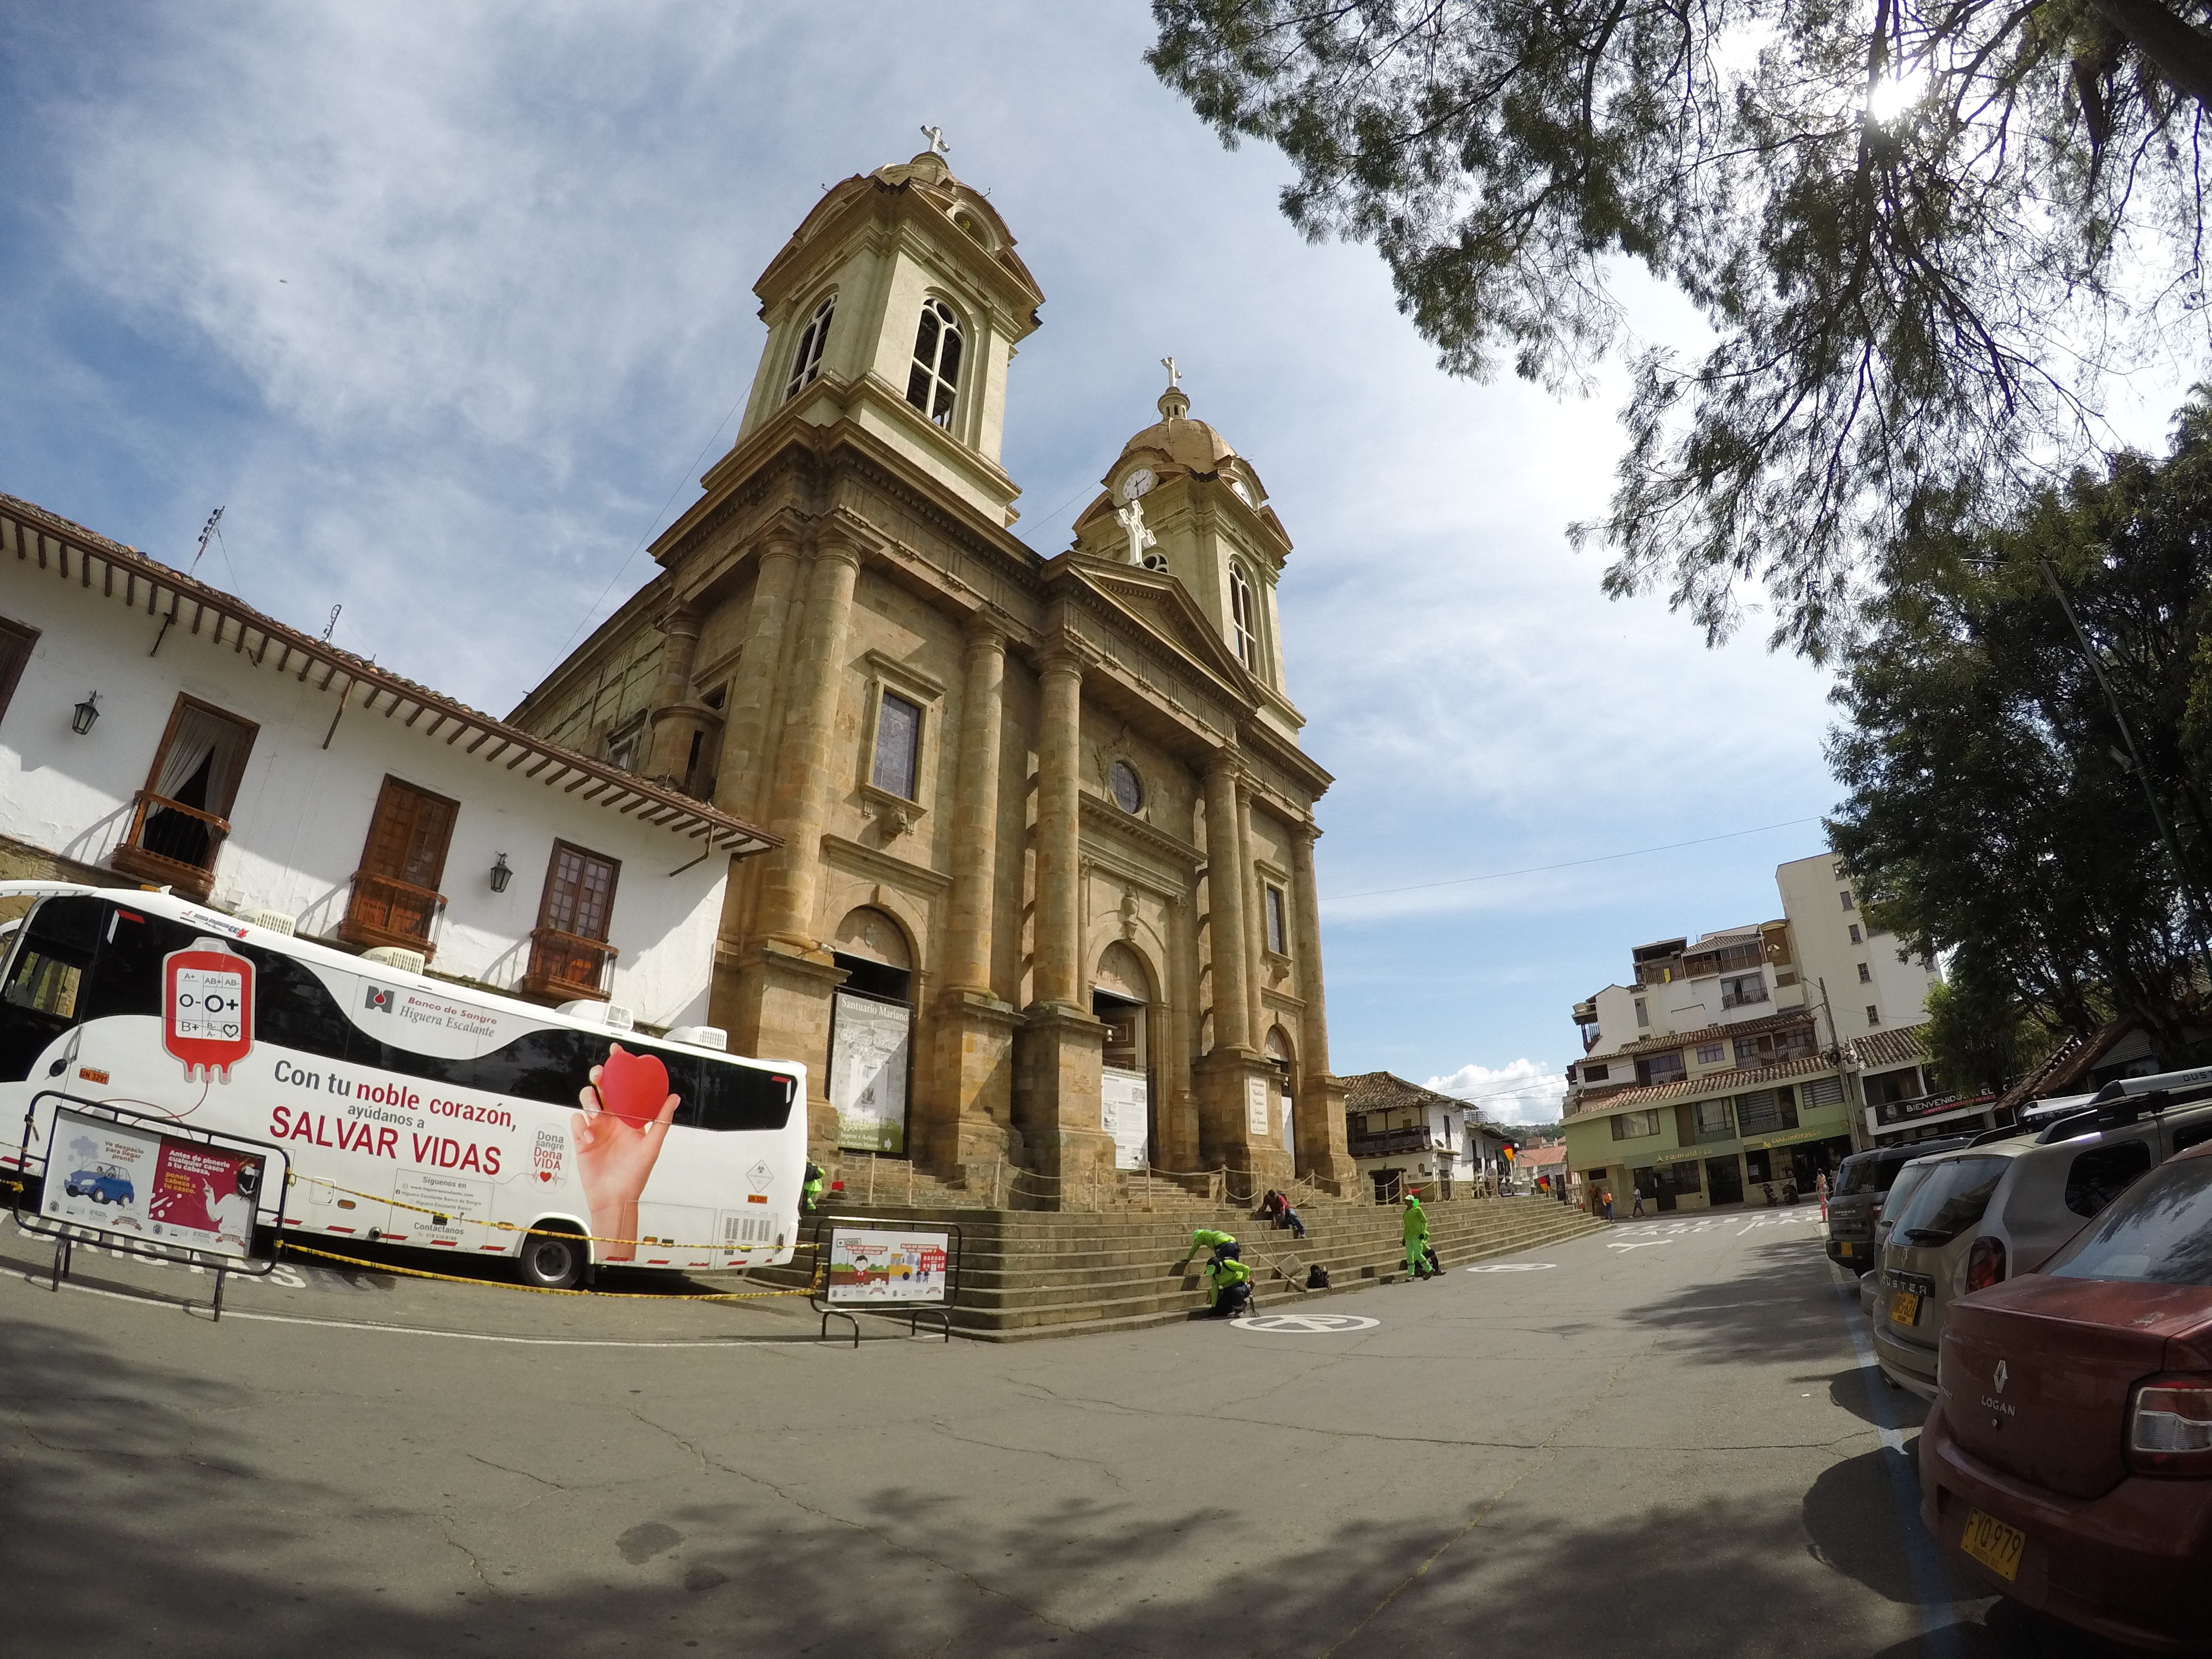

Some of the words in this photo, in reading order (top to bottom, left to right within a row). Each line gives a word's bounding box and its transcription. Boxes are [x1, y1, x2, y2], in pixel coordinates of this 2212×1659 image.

[179, 994, 201, 1008] O-
[205, 995, 238, 1013] O+
[408, 997, 441, 1011] Banco
[444, 1006, 457, 1015] de
[460, 1010, 497, 1024] Sangre
[842, 997, 877, 1015] Santuario
[879, 1006, 908, 1022] Mariano
[181, 1021, 199, 1031] B+
[399, 1005, 442, 1026] Higuera
[446, 1017, 494, 1037] Escalante
[274, 1060, 320, 1090] Con
[328, 1073, 351, 1097] tu
[356, 1083, 420, 1110] noble
[429, 1103, 517, 1131] corazón,
[1981, 1087, 1994, 1095] EL
[347, 1103, 413, 1127] ayúdanos
[417, 1118, 425, 1129] a
[270, 1106, 398, 1159] SALVAR
[413, 1133, 502, 1175] VIDAS
[538, 1130, 564, 1143] Dona
[114, 1143, 144, 1154] despacio
[535, 1140, 564, 1150] sangre
[112, 1154, 134, 1163] pronto
[122, 1150, 141, 1159] llegar
[169, 1150, 191, 1160] Antes
[534, 1146, 562, 1160] Dona
[168, 1156, 202, 1168] cualquier
[204, 1164, 225, 1172] casco
[534, 1157, 561, 1170] VIDA
[165, 1177, 190, 1187] cabeza
[1754, 1215, 1824, 1227] PAR
[1981, 1395, 2016, 1417] LOGAN
